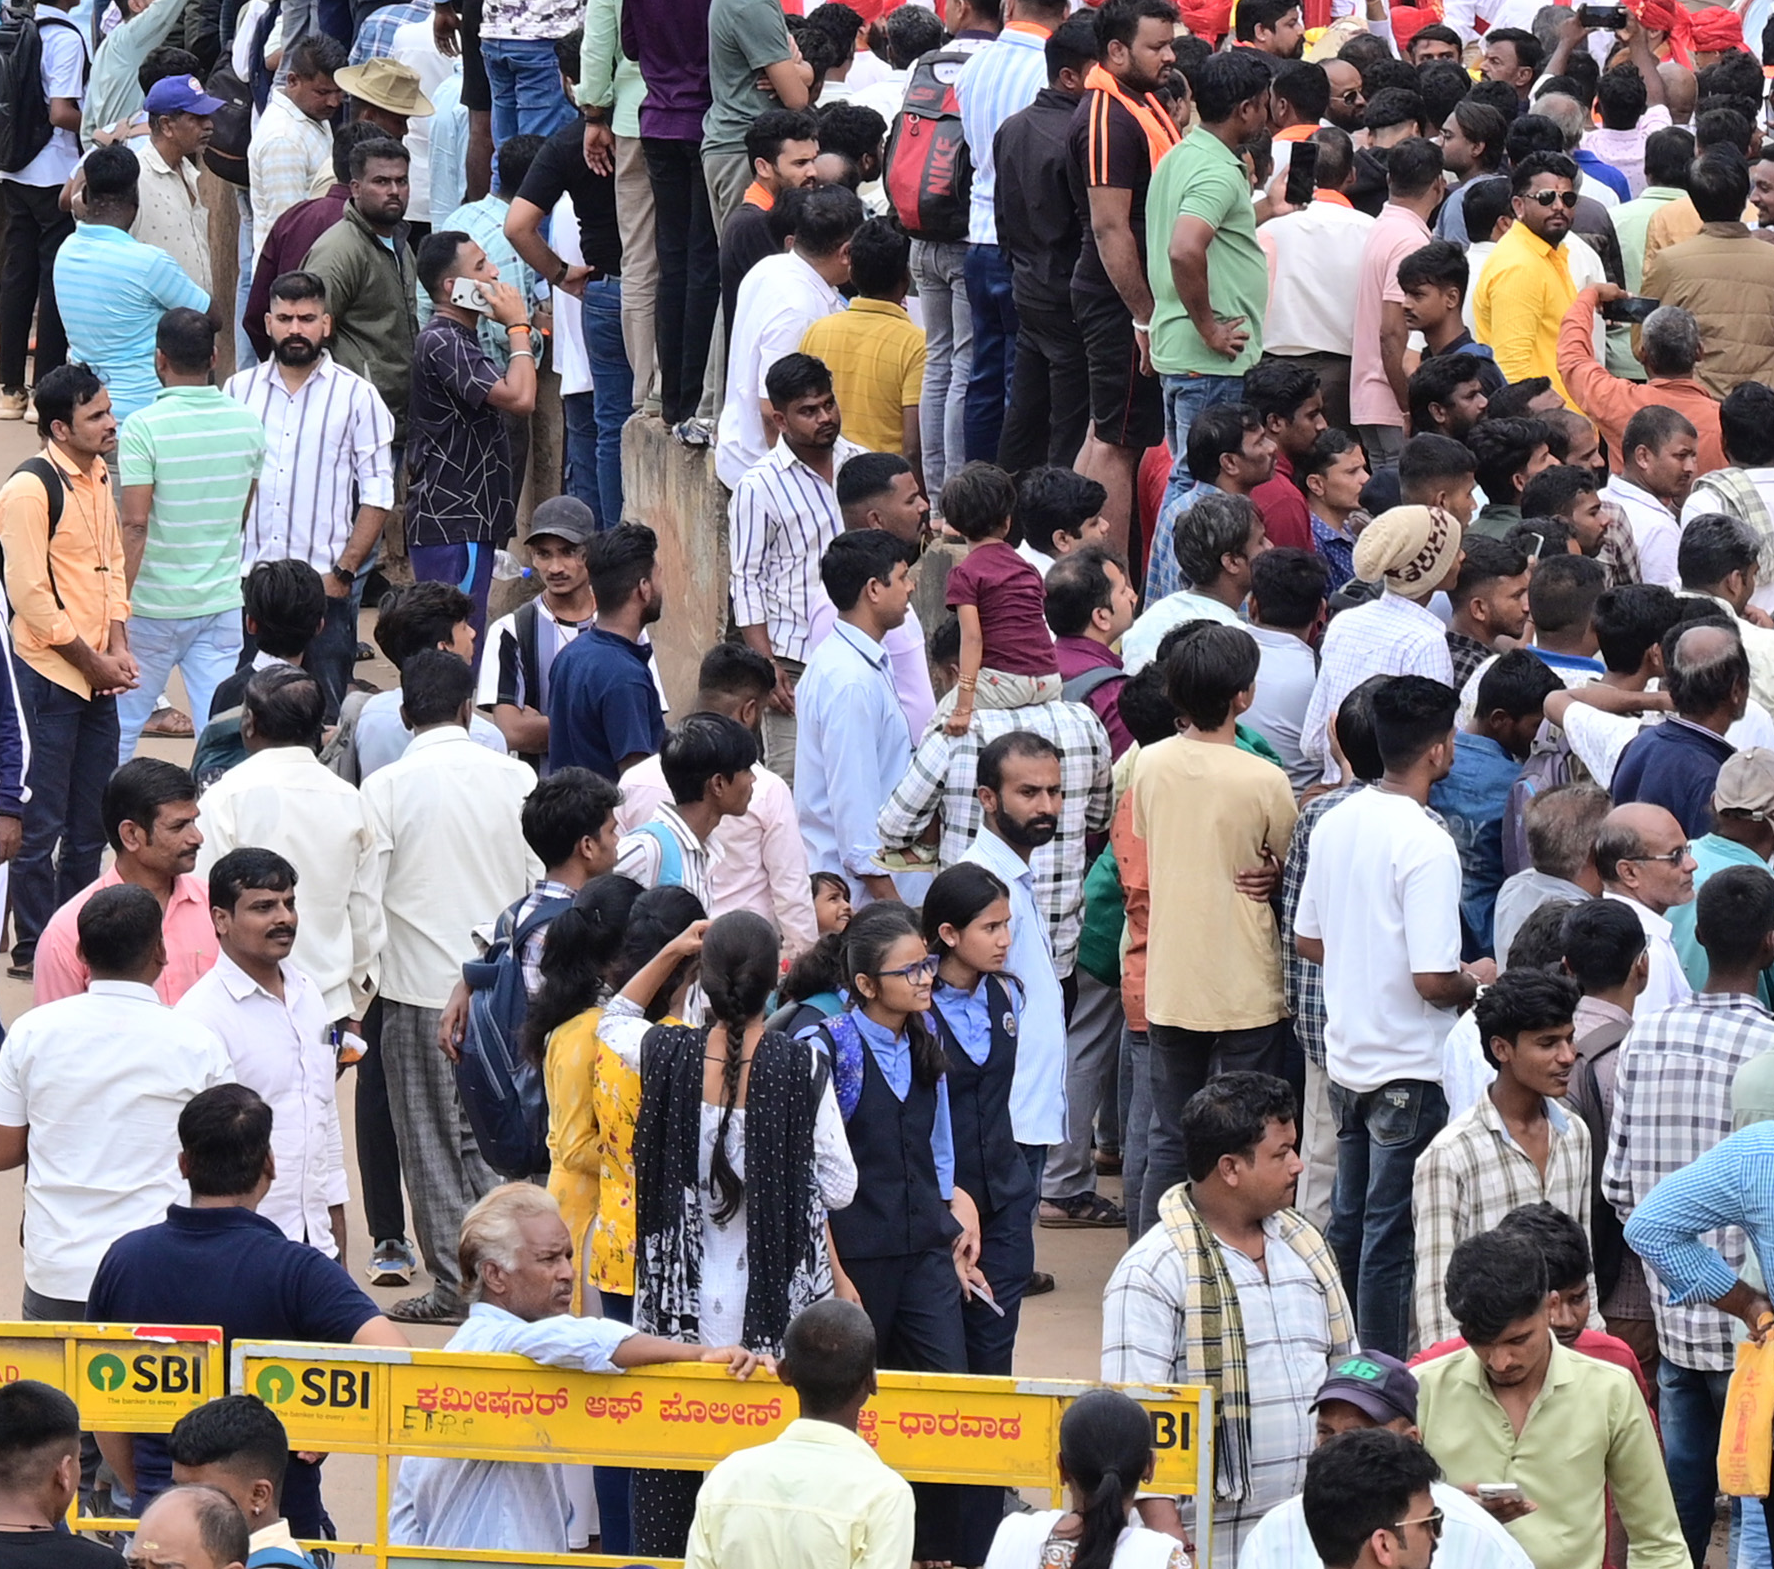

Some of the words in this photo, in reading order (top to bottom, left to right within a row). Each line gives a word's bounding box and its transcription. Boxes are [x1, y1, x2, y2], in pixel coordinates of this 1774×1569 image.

[927, 135, 956, 196] NIKE
[132, 1353, 202, 1395] SBI
[301, 1367, 371, 1410] SBI
[1336, 1358, 1382, 1380] 46
[107, 1396, 120, 1405] The
[121, 1396, 143, 1406] banker
[153, 1398, 177, 1408] every
[288, 1410, 315, 1418] banker
[325, 1413, 345, 1422] every
[585, 1390, 643, 1424] ಆಫ್
[660, 1393, 783, 1428] ಪೊಲೀಸ್
[1148, 1410, 1191, 1451] BI
